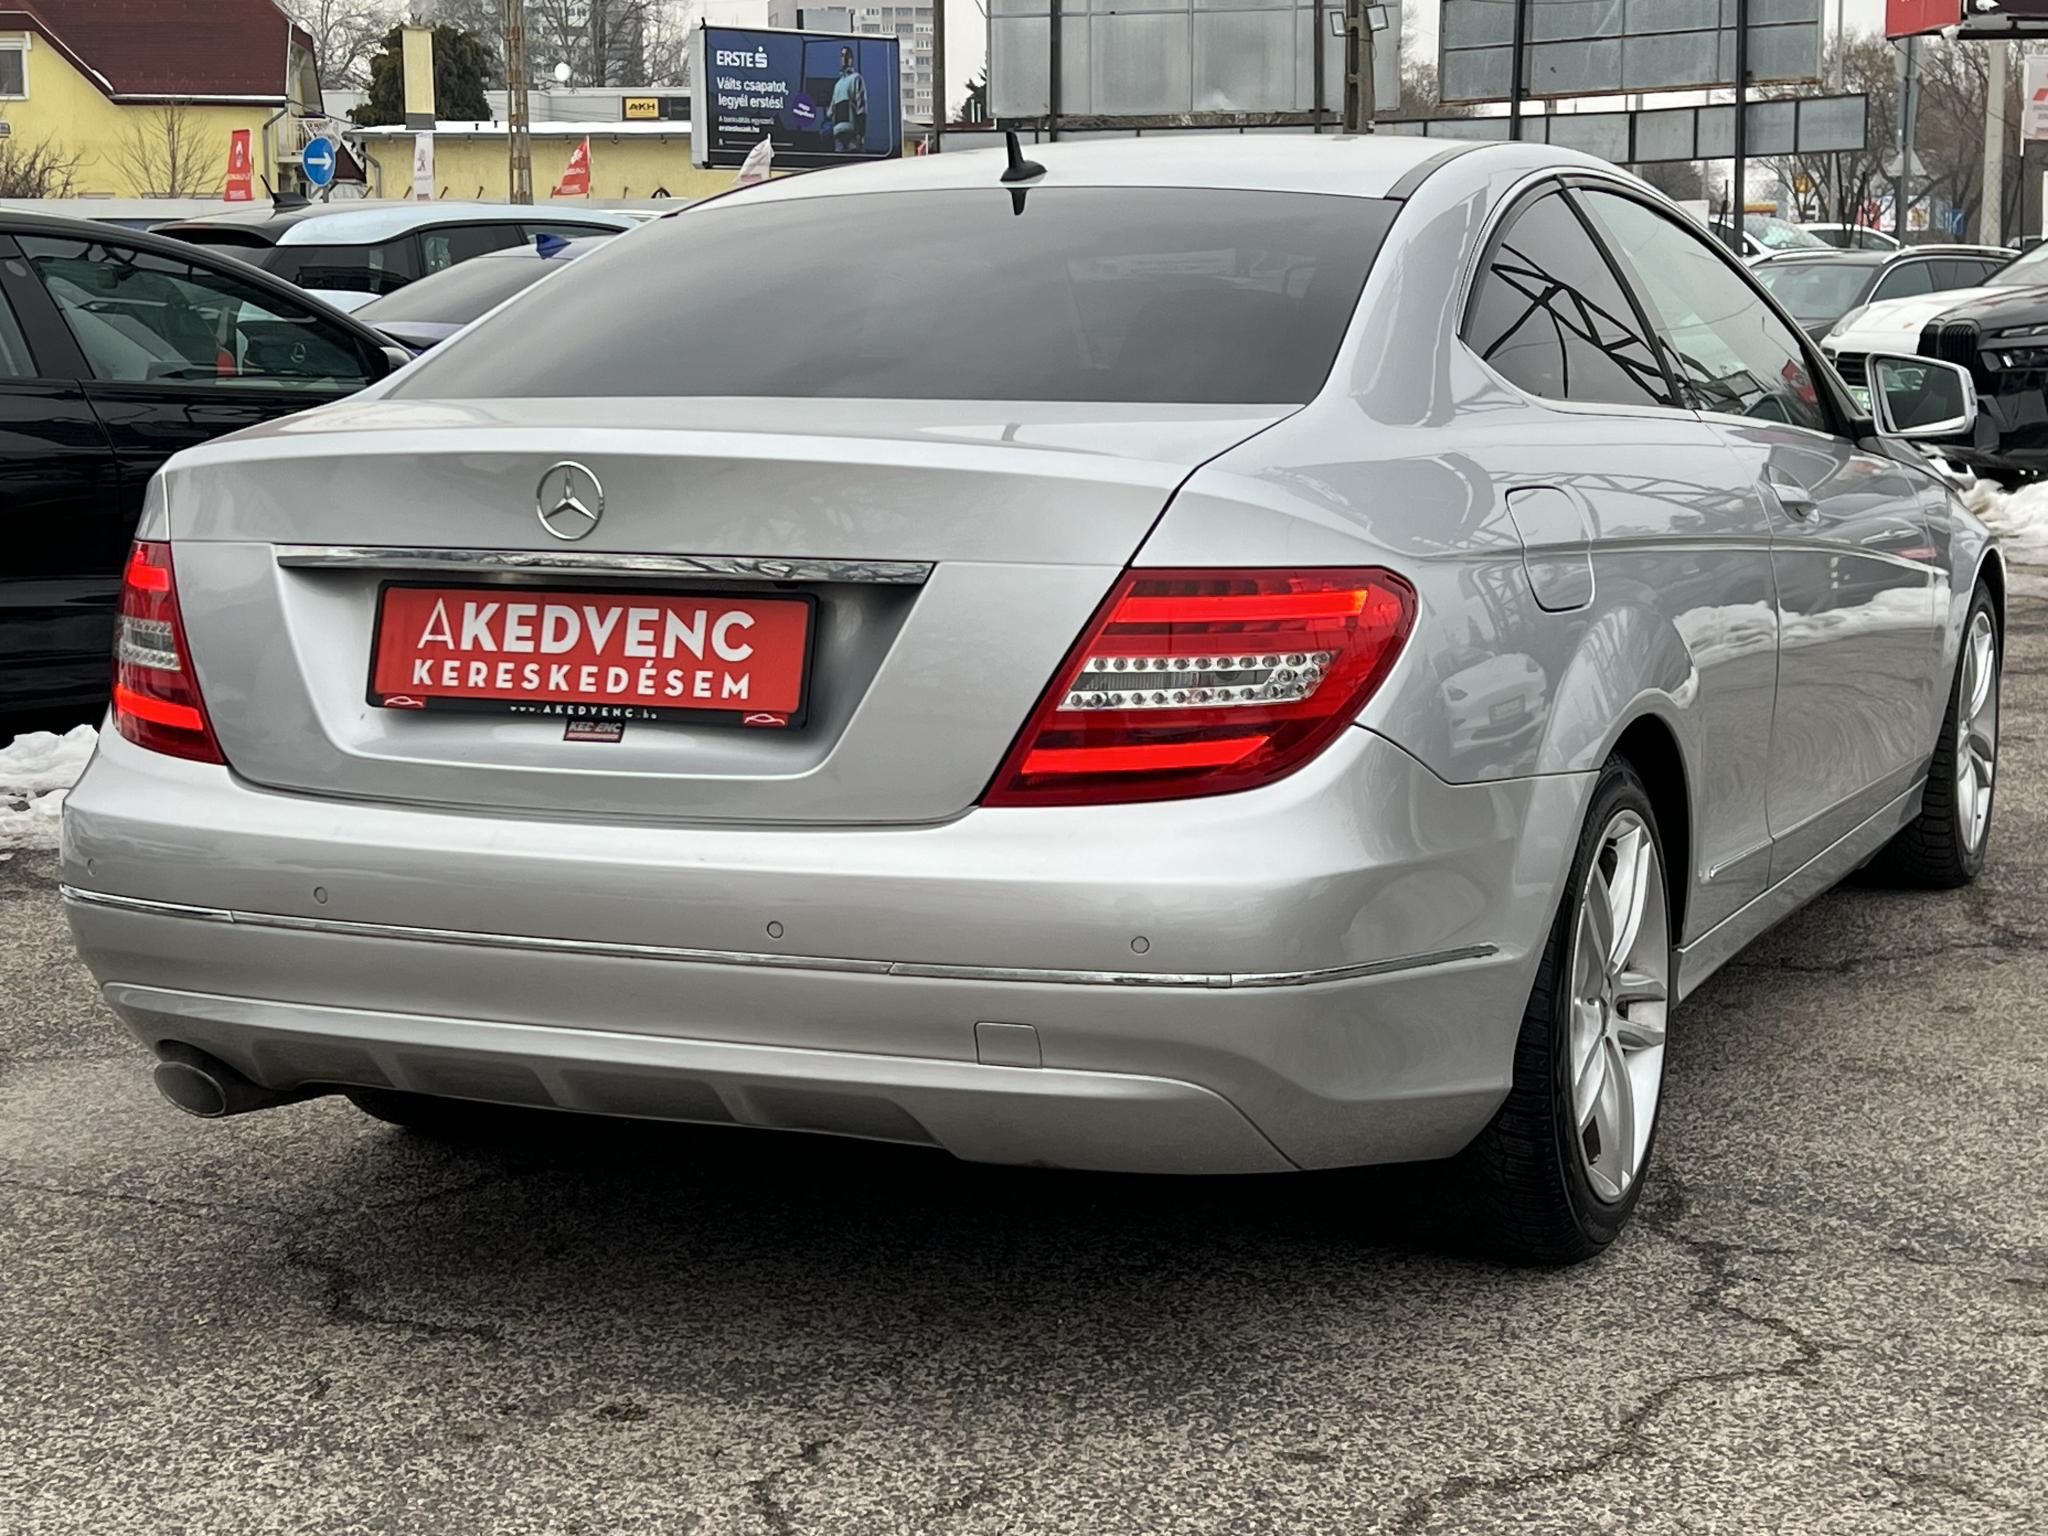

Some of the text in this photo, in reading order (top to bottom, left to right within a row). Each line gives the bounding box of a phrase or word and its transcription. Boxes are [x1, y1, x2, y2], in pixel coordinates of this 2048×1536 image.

[716, 50, 754, 67] ERSTE
[716, 76, 789, 95] Válts csapatot,
[628, 103, 656, 111] AKH
[718, 93, 784, 110] legyél erstés!
[416, 598, 756, 663] AKEDVENC
[412, 658, 752, 700] KERESKEDÉSEM
